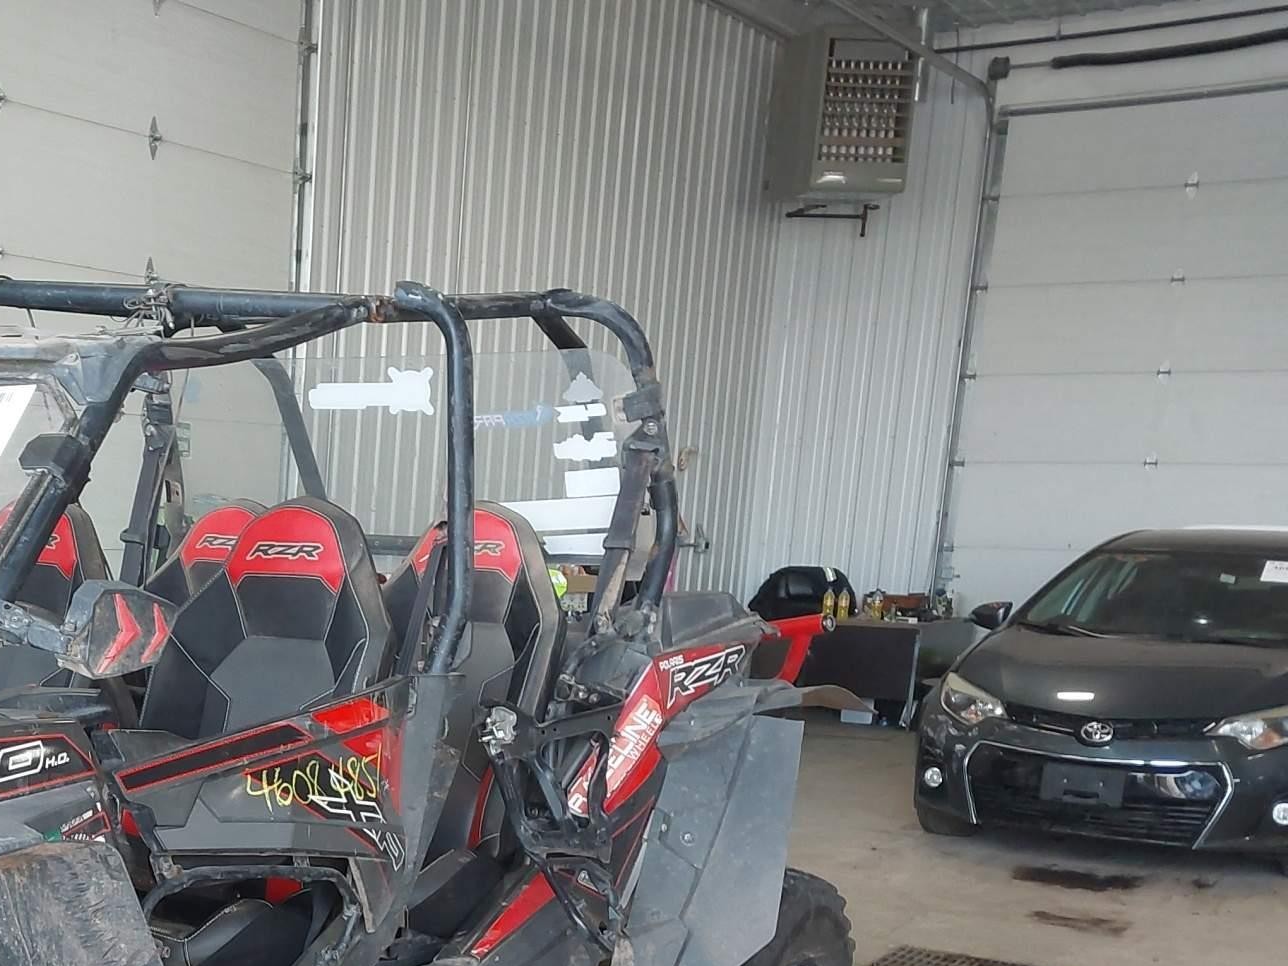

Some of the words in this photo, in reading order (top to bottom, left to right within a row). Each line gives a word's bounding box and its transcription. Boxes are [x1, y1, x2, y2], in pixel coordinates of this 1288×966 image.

[246, 541, 325, 561] RZR
[659, 654, 685, 671] POLARIS
[666, 644, 746, 710] RZR
[45, 752, 70, 769] H.O.
